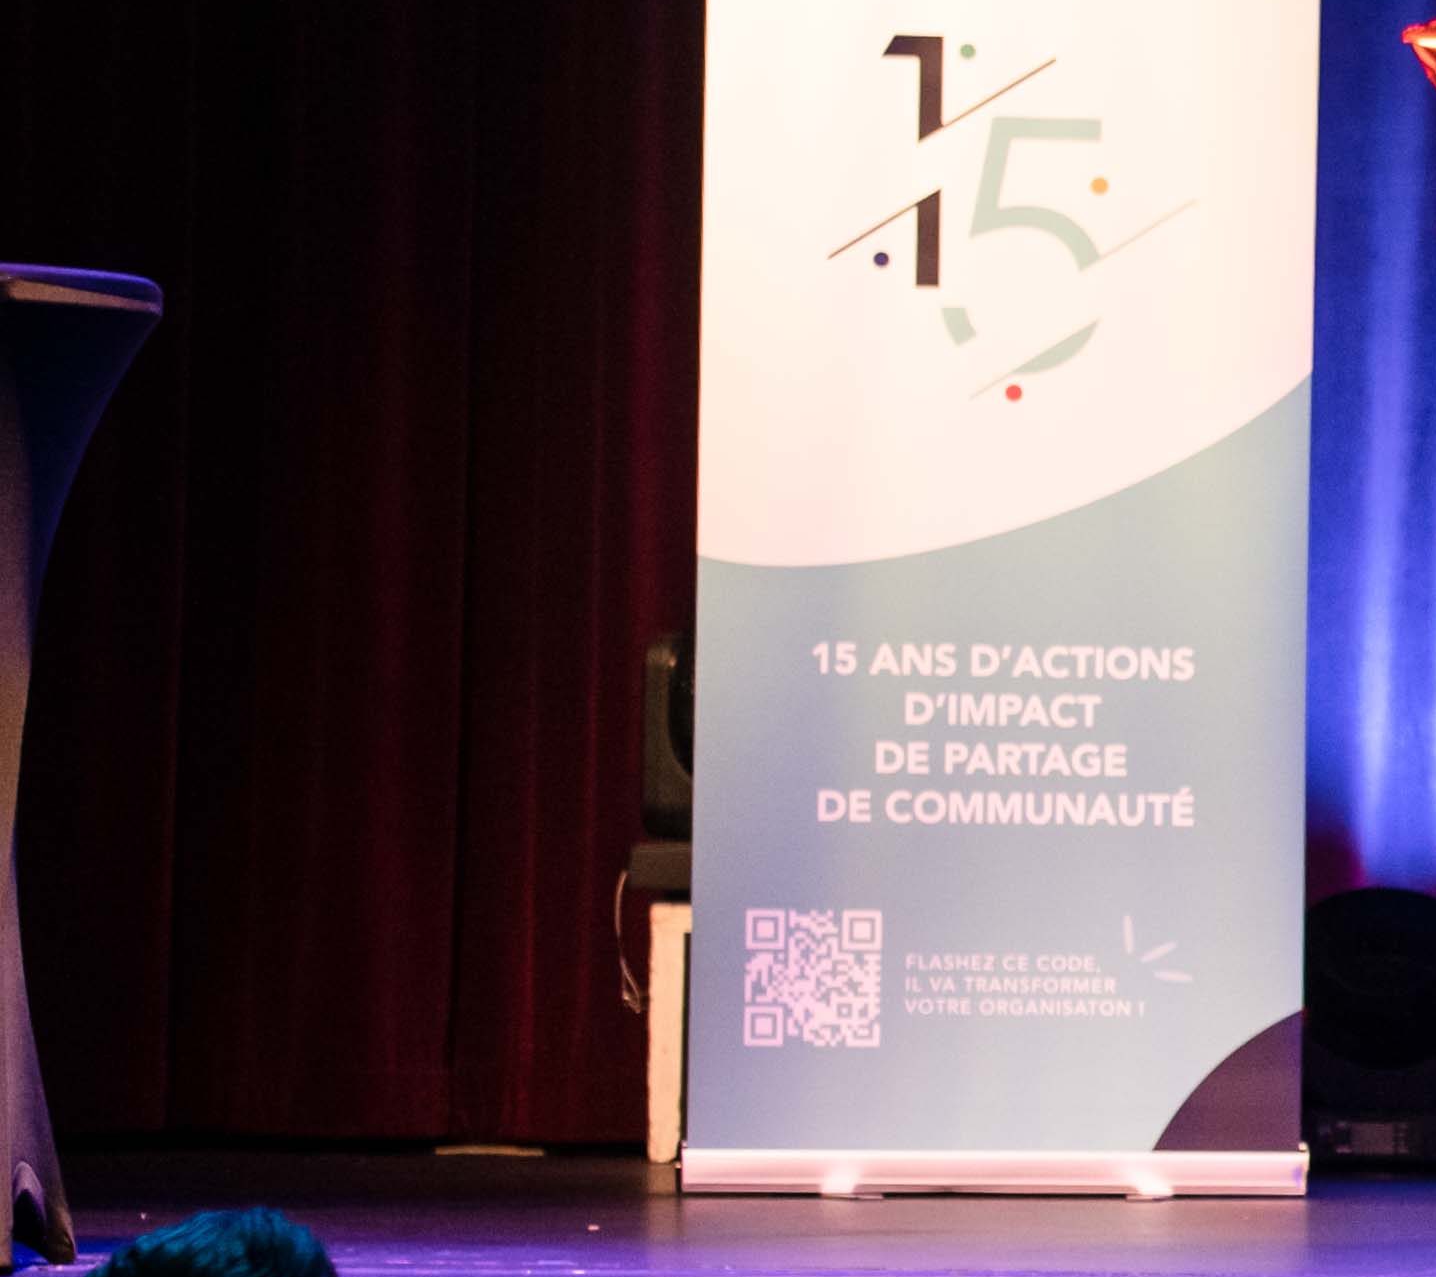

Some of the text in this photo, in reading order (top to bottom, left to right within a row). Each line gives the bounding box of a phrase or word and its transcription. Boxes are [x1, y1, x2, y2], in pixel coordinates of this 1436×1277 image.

[811, 642, 1196, 681] 15 ANS D’ACTIONS
[904, 692, 1102, 728] D’IMPACT
[874, 740, 1128, 778] DE PARTAGE
[816, 787, 1194, 828] DE COMMUNAUTÉ
[905, 953, 995, 972] FLASHEZ
[1002, 954, 1029, 973] CE
[904, 976, 1117, 995] IL VA TRANSFORMER
[904, 998, 971, 1016] VOTRE
[979, 998, 1131, 1018] ORGANISATON
